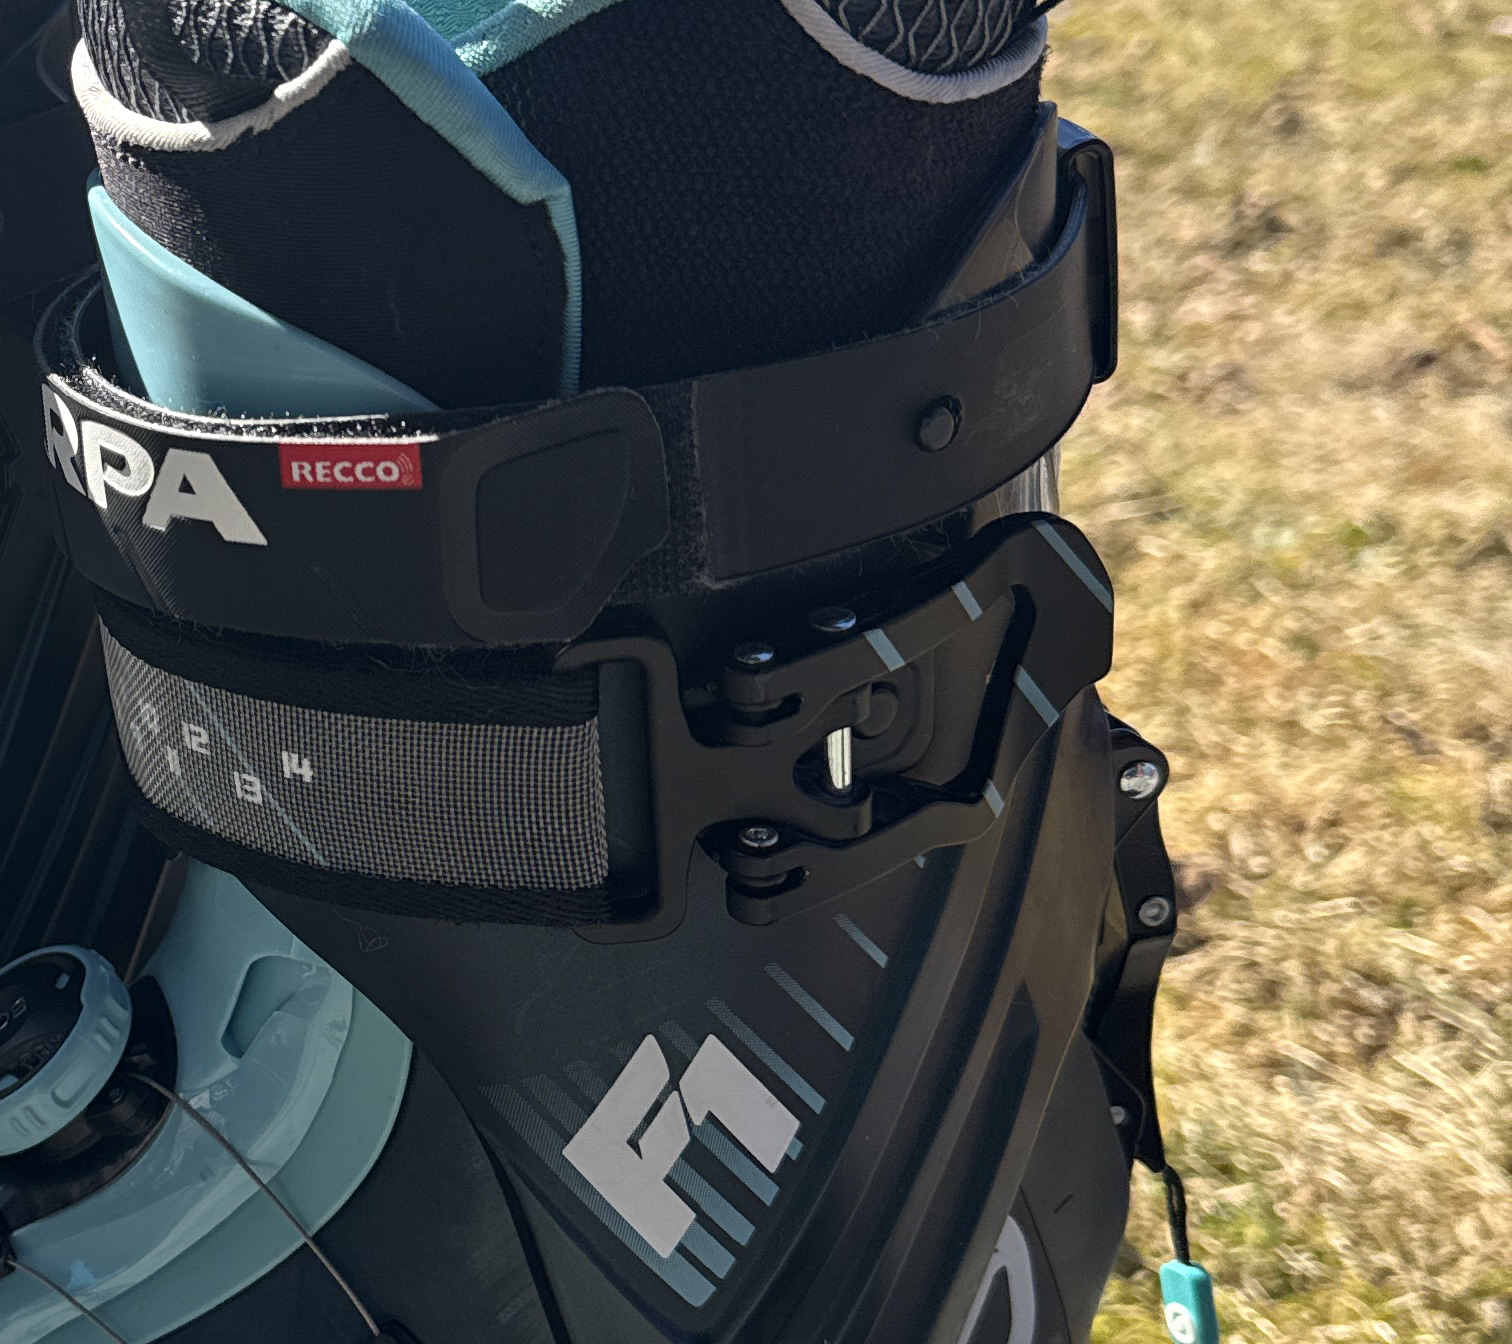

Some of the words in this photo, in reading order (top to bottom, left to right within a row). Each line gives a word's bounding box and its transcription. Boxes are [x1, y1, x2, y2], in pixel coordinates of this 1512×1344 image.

[41, 383, 268, 546] RPA
[290, 459, 400, 484] RECCO
[282, 751, 313, 783] 14
[562, 1034, 800, 1259] F1
